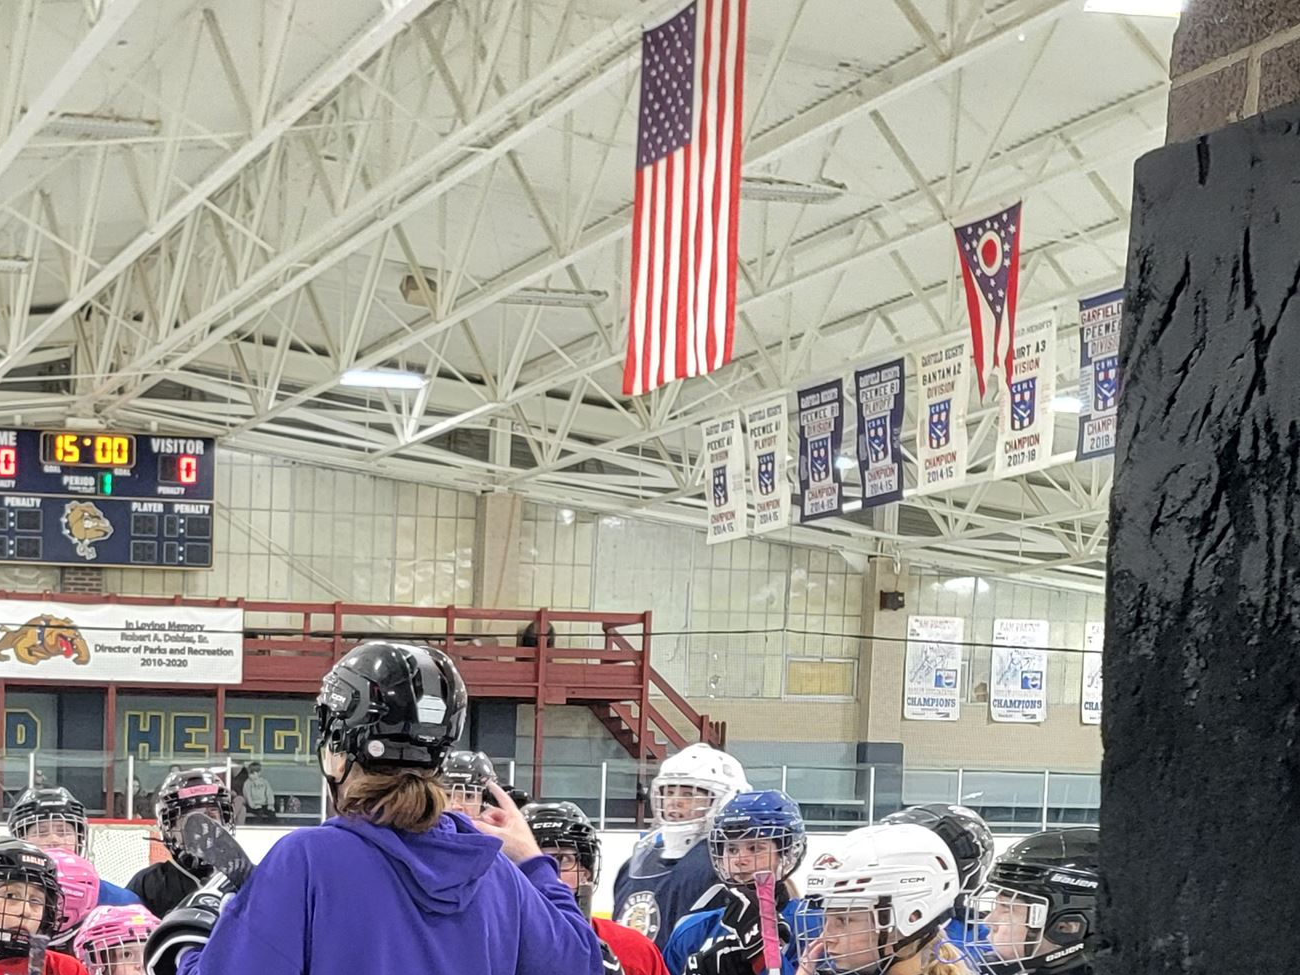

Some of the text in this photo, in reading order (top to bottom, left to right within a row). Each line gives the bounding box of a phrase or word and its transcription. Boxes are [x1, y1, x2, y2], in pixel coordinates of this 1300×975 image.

[1014, 357, 1041, 376] VISION
[1086, 419, 1116, 436] CHAMPI
[151, 437, 205, 455] VISITOR
[1003, 433, 1041, 454] CHAMPION
[924, 451, 957, 470] CHAMPION
[180, 457, 197, 483] 0
[63, 475, 96, 487] PERIOD
[103, 472, 113, 496] 1
[3, 496, 42, 508] PENALTY
[131, 502, 210, 515] PLAYER PENALTY
[168, 621, 205, 632] Memory
[120, 632, 152, 642] Robert
[94, 644, 234, 657] Director of Parks and Recreation
[140, 657, 188, 668] 2010-2020
[906, 696, 956, 708] CHAMPIONS
[992, 698, 1043, 709] CHAMPIONS
[124, 710, 320, 764] HEIG
[532, 821, 563, 830] CCM
[807, 878, 825, 886] CCM
[1051, 872, 1099, 888] BAUER
[1045, 942, 1085, 962] BAUER
